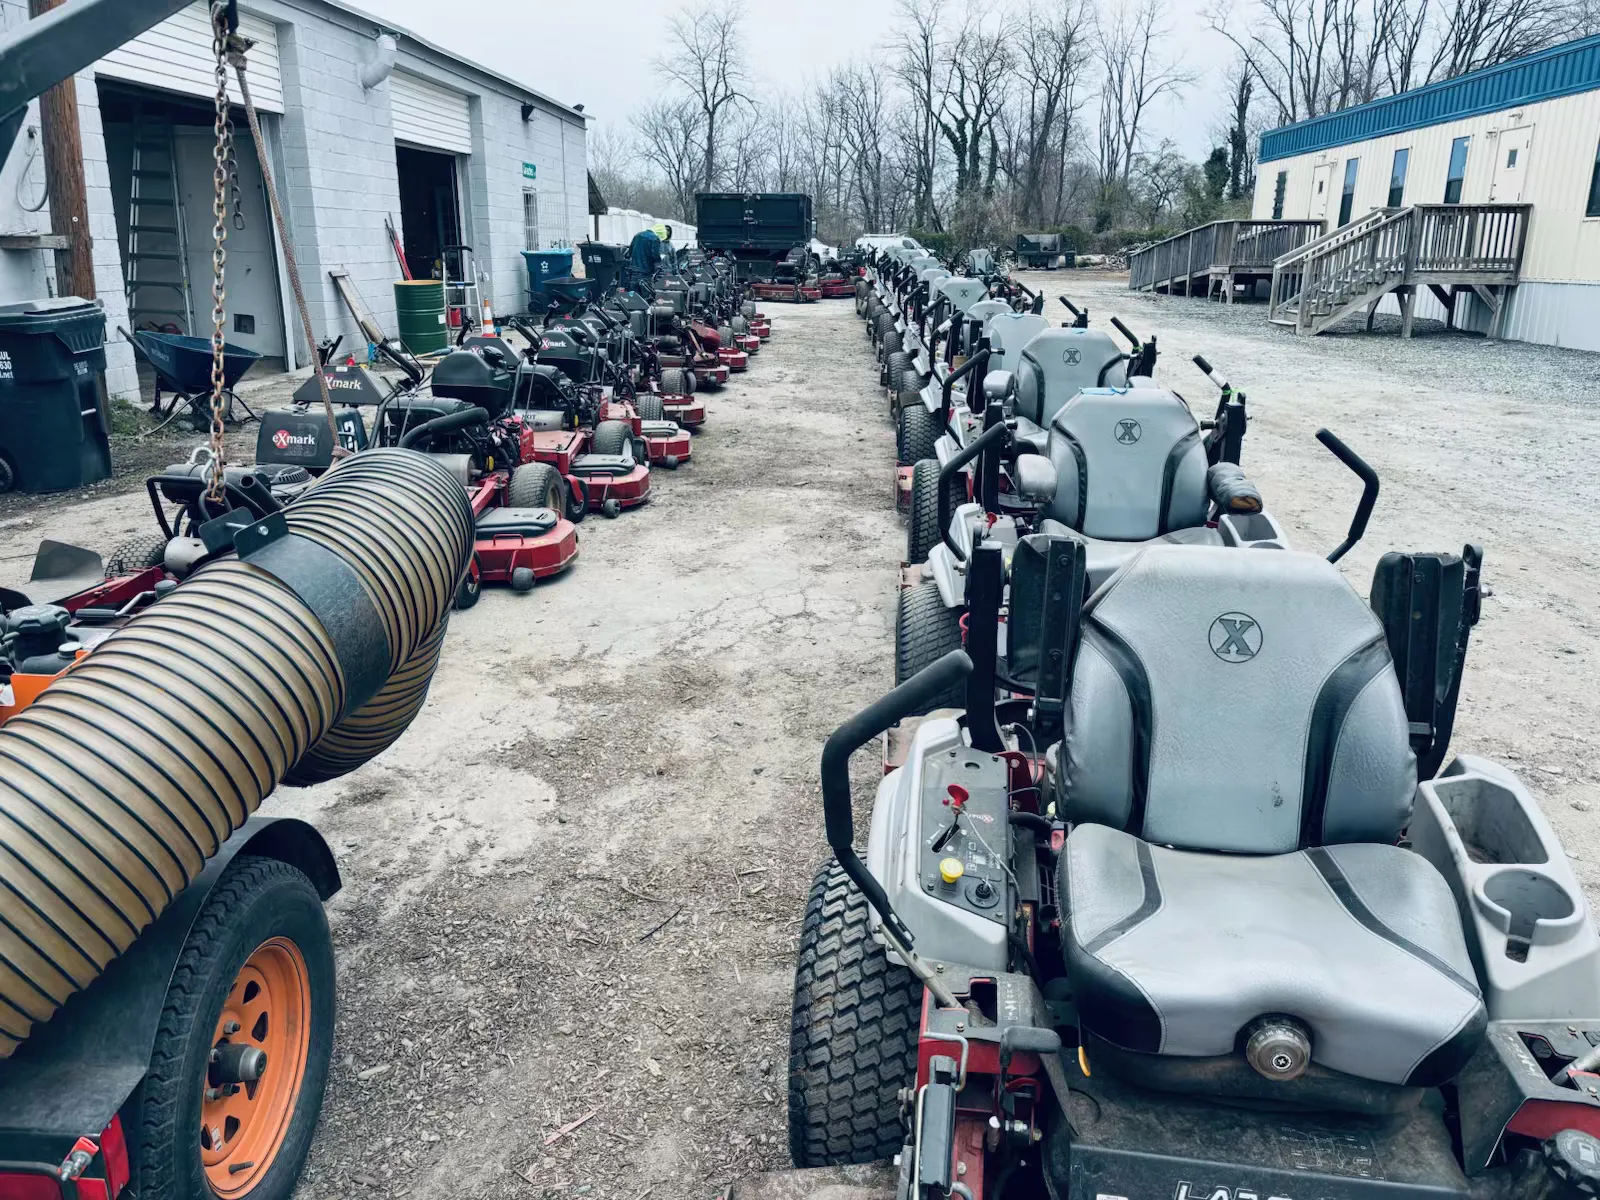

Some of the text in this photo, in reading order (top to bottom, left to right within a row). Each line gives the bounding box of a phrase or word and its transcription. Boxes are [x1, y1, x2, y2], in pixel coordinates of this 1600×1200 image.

[540, 339, 567, 348] Xmark
[324, 375, 361, 390] Xmark
[1118, 422, 1138, 441] X
[272, 432, 315, 447] eXmark
[1215, 617, 1255, 657] X
